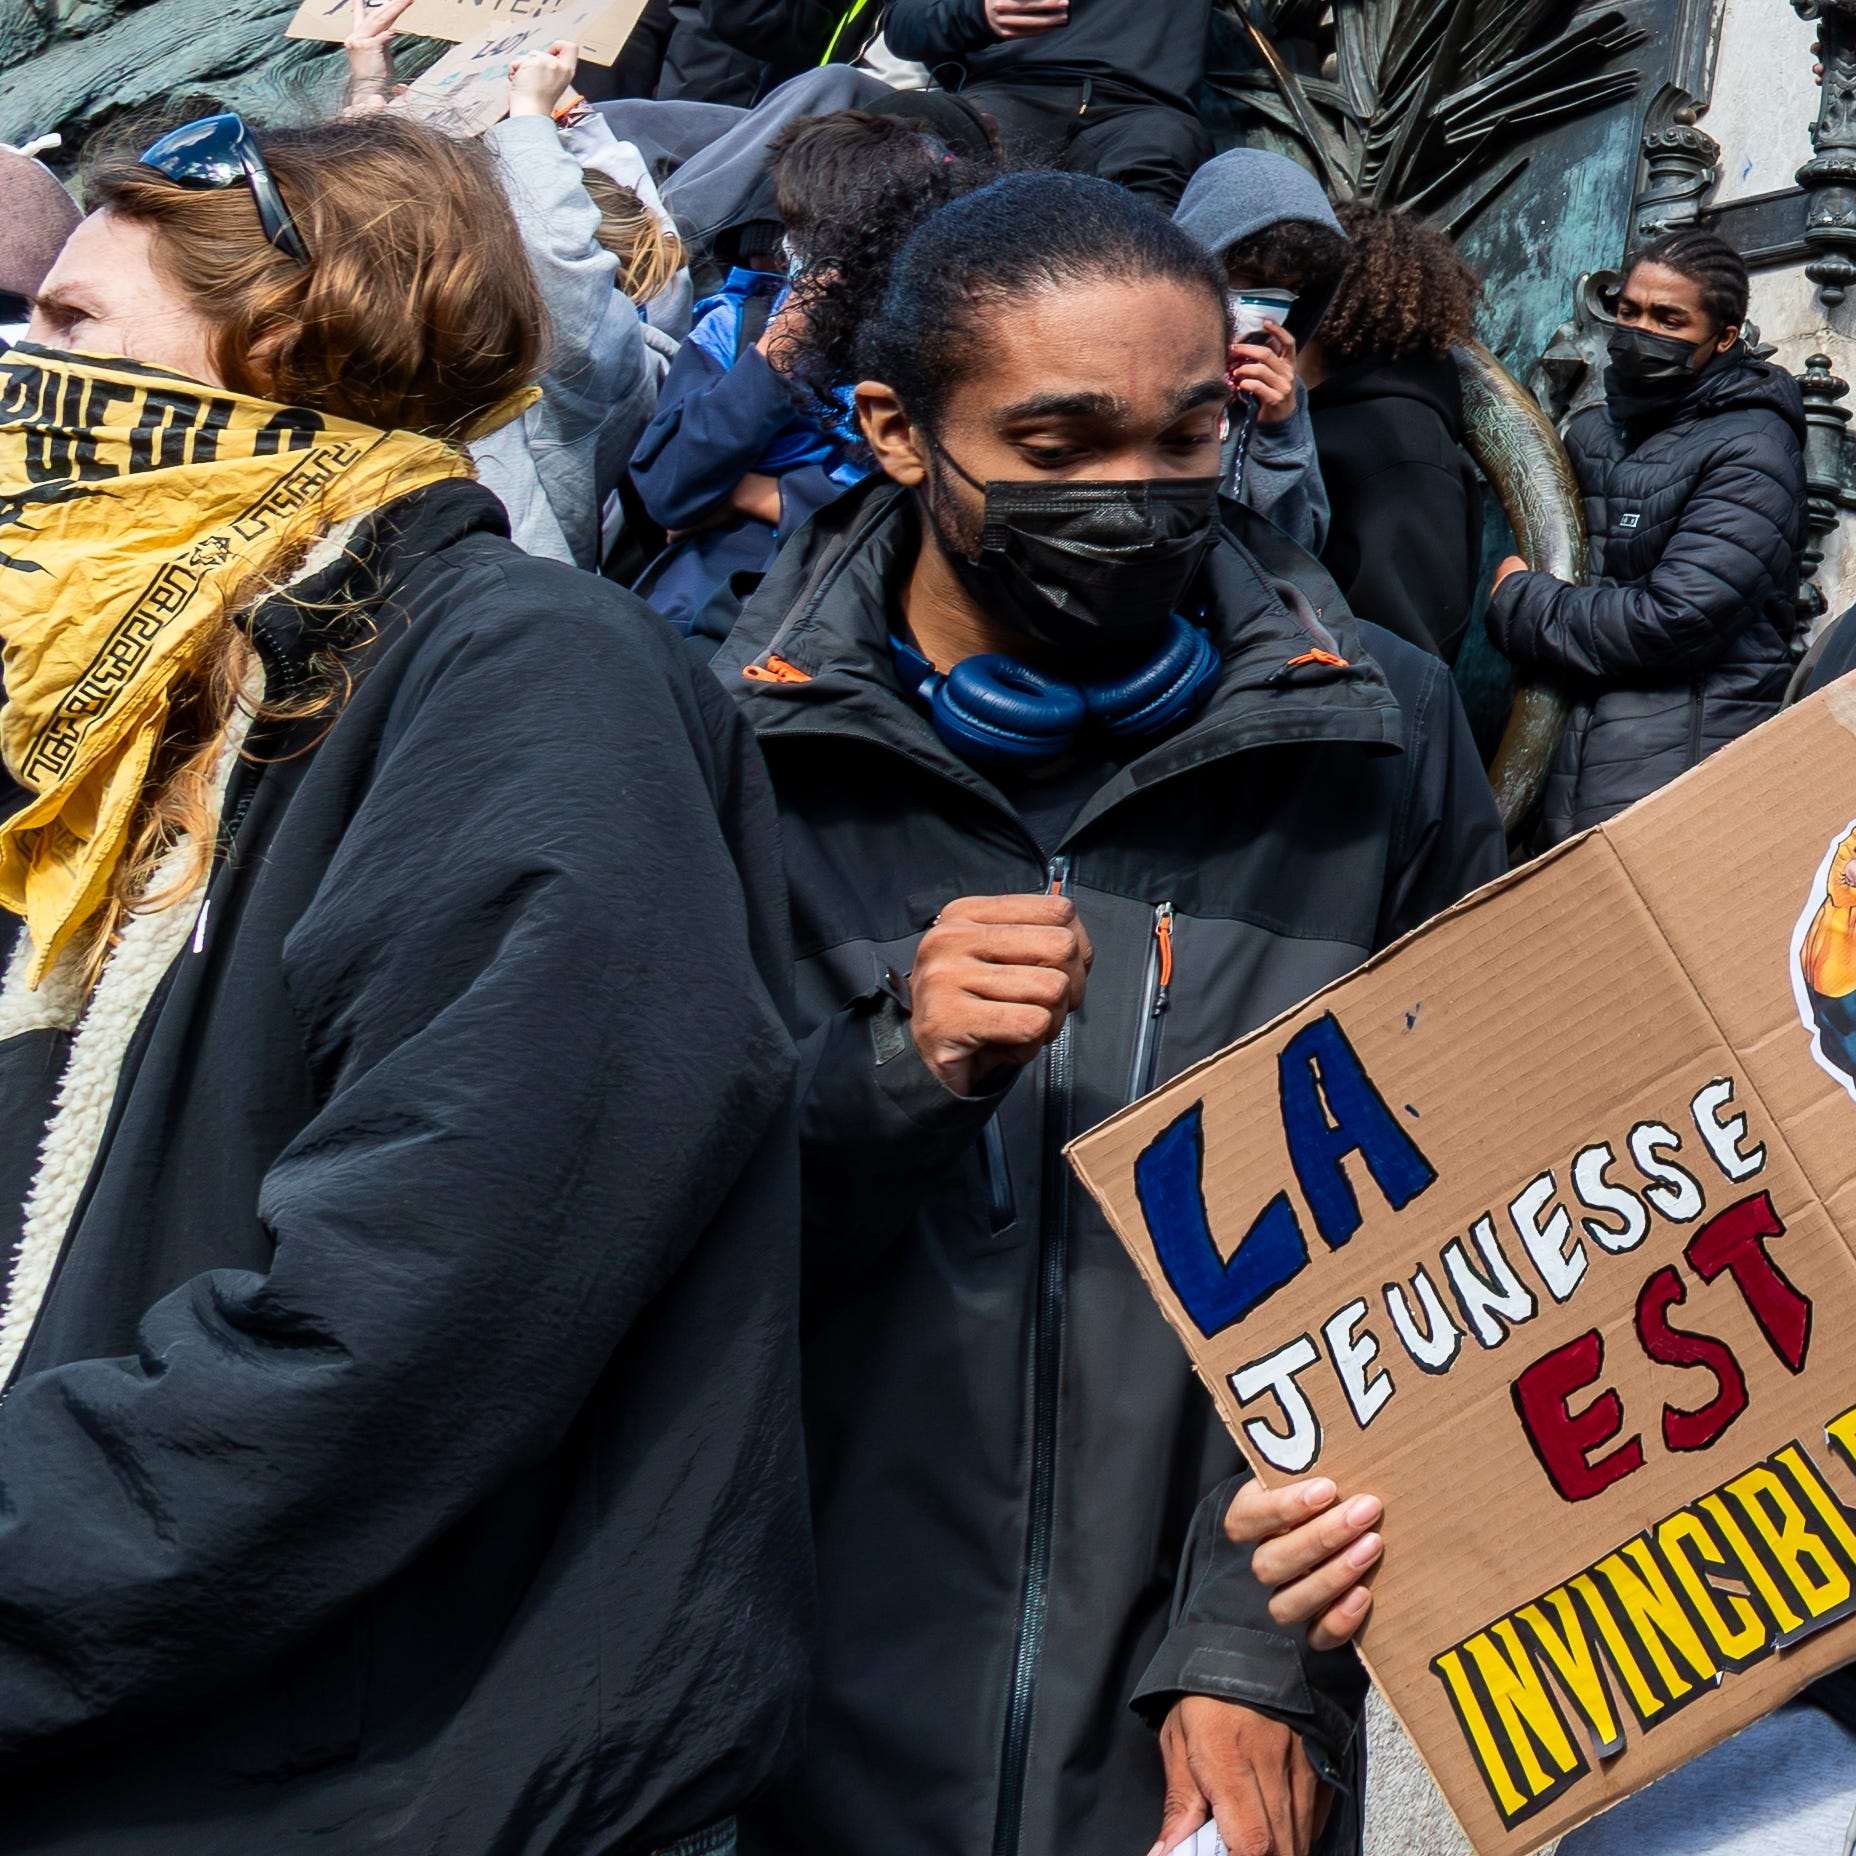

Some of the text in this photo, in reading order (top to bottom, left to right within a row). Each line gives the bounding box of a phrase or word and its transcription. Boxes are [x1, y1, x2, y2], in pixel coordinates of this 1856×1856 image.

[1128, 1007, 1439, 1340] LA
[1223, 1075, 1772, 1476] JEUNESSE
[1509, 1190, 1814, 1504] EST
